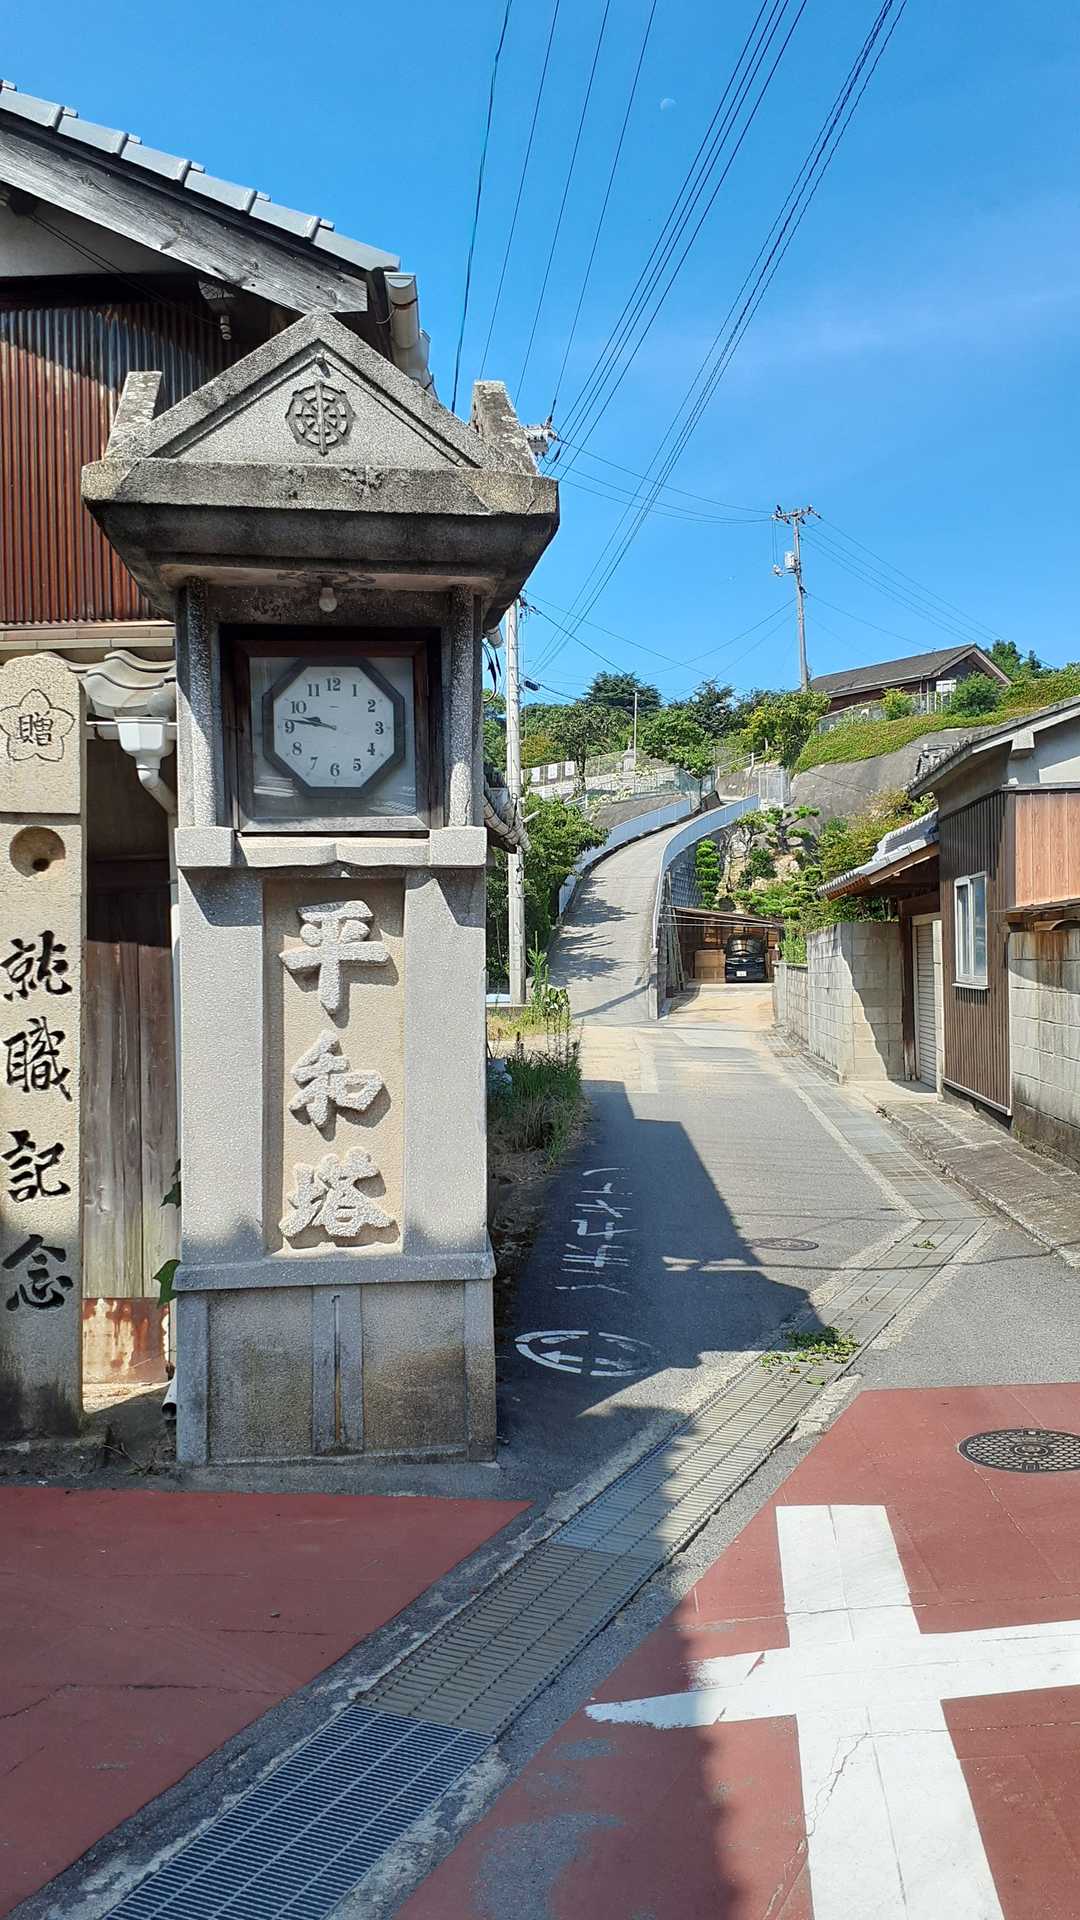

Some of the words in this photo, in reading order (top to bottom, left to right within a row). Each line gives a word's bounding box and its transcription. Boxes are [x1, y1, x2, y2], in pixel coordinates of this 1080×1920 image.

[307, 683, 320, 697] 11
[325, 677, 341, 692] 12
[352, 683, 358, 697] 1
[290, 701, 307, 714] 10
[367, 699, 376, 713] 2
[16, 710, 54, 746] 贈
[284, 719, 295, 734] 9
[375, 721, 384, 735] 3
[292, 741, 302, 756] 8
[367, 742, 376, 756] 4
[310, 756, 318, 770] 7
[330, 763, 340, 777] 6
[352, 758, 361, 771] 5
[278, 900, 397, 1238] 平和塔
[0, 930, 73, 1312] 就職記念
